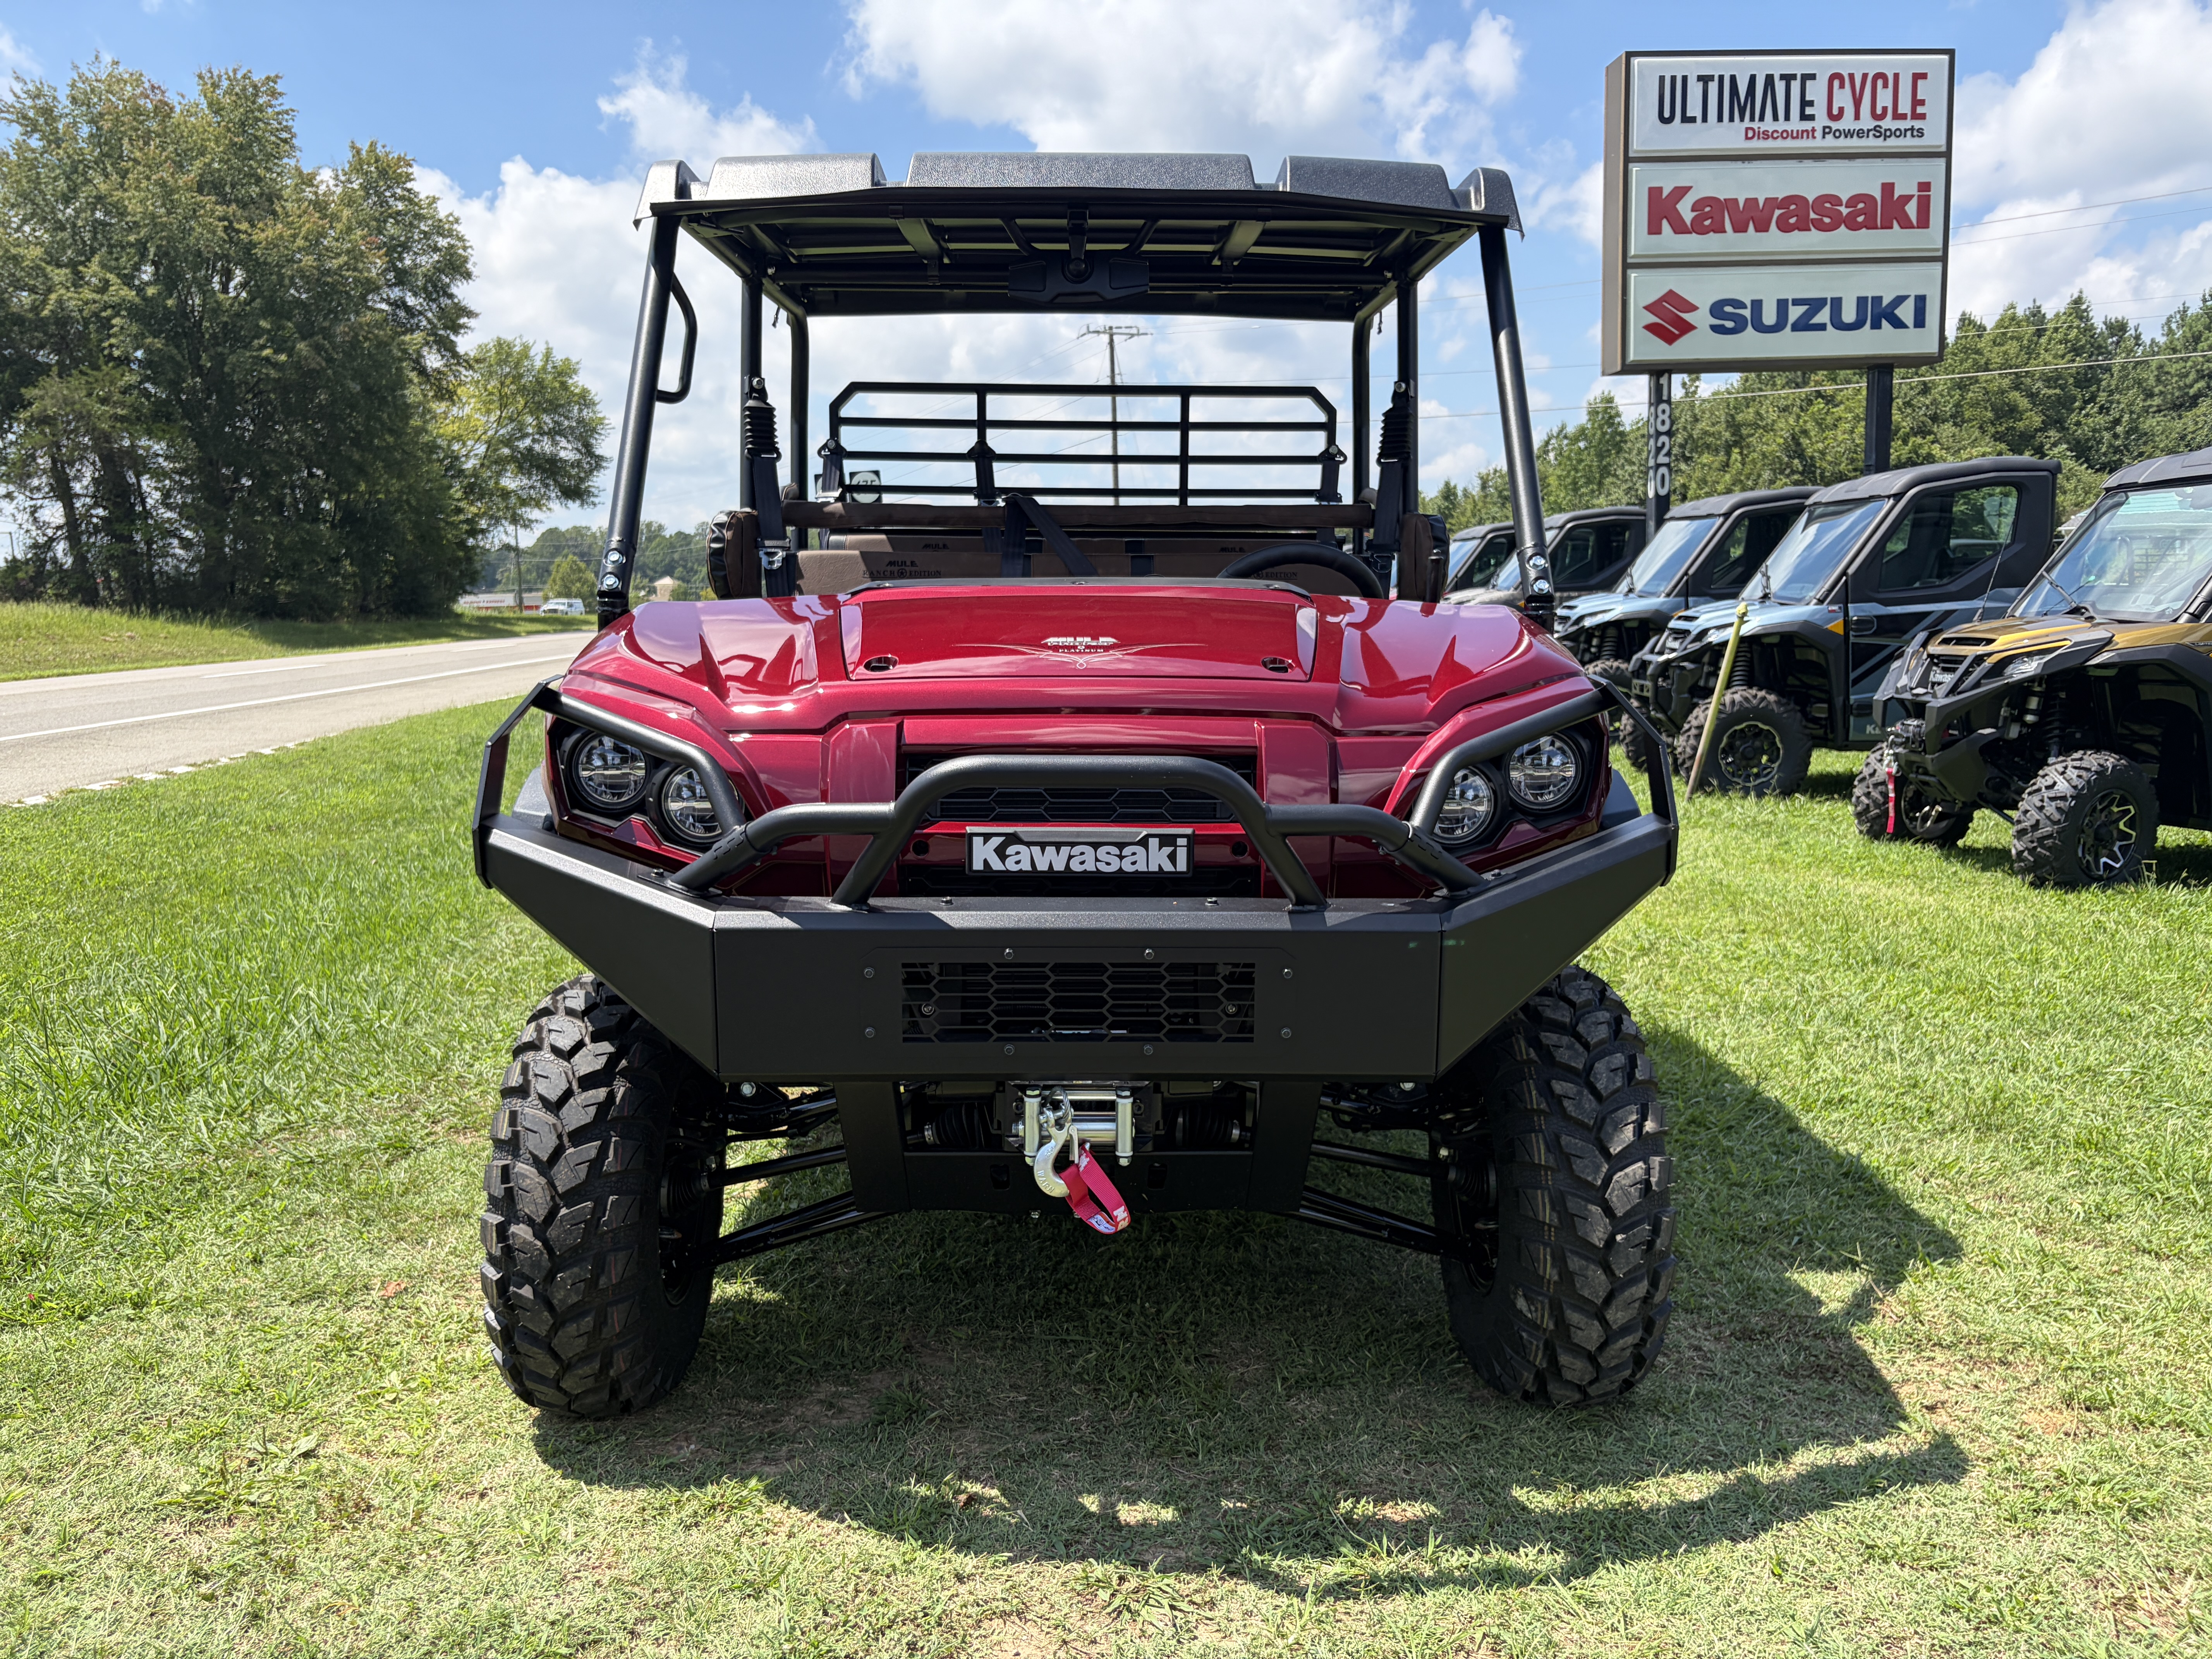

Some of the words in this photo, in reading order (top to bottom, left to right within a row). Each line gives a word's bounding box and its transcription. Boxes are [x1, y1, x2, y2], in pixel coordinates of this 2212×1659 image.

[1658, 73, 1817, 124] ULTIMATE
[1827, 72, 1928, 121] CYCLE
[1744, 127, 1816, 140] Discount
[1822, 125, 1925, 140] PowerSports
[1647, 181, 1932, 235] Kawasaki
[1709, 294, 1927, 335] SUZUKI
[1656, 373, 1670, 496] 1820
[972, 836, 1187, 872] Kawasaki
[1037, 1170, 1055, 1193] WARN
